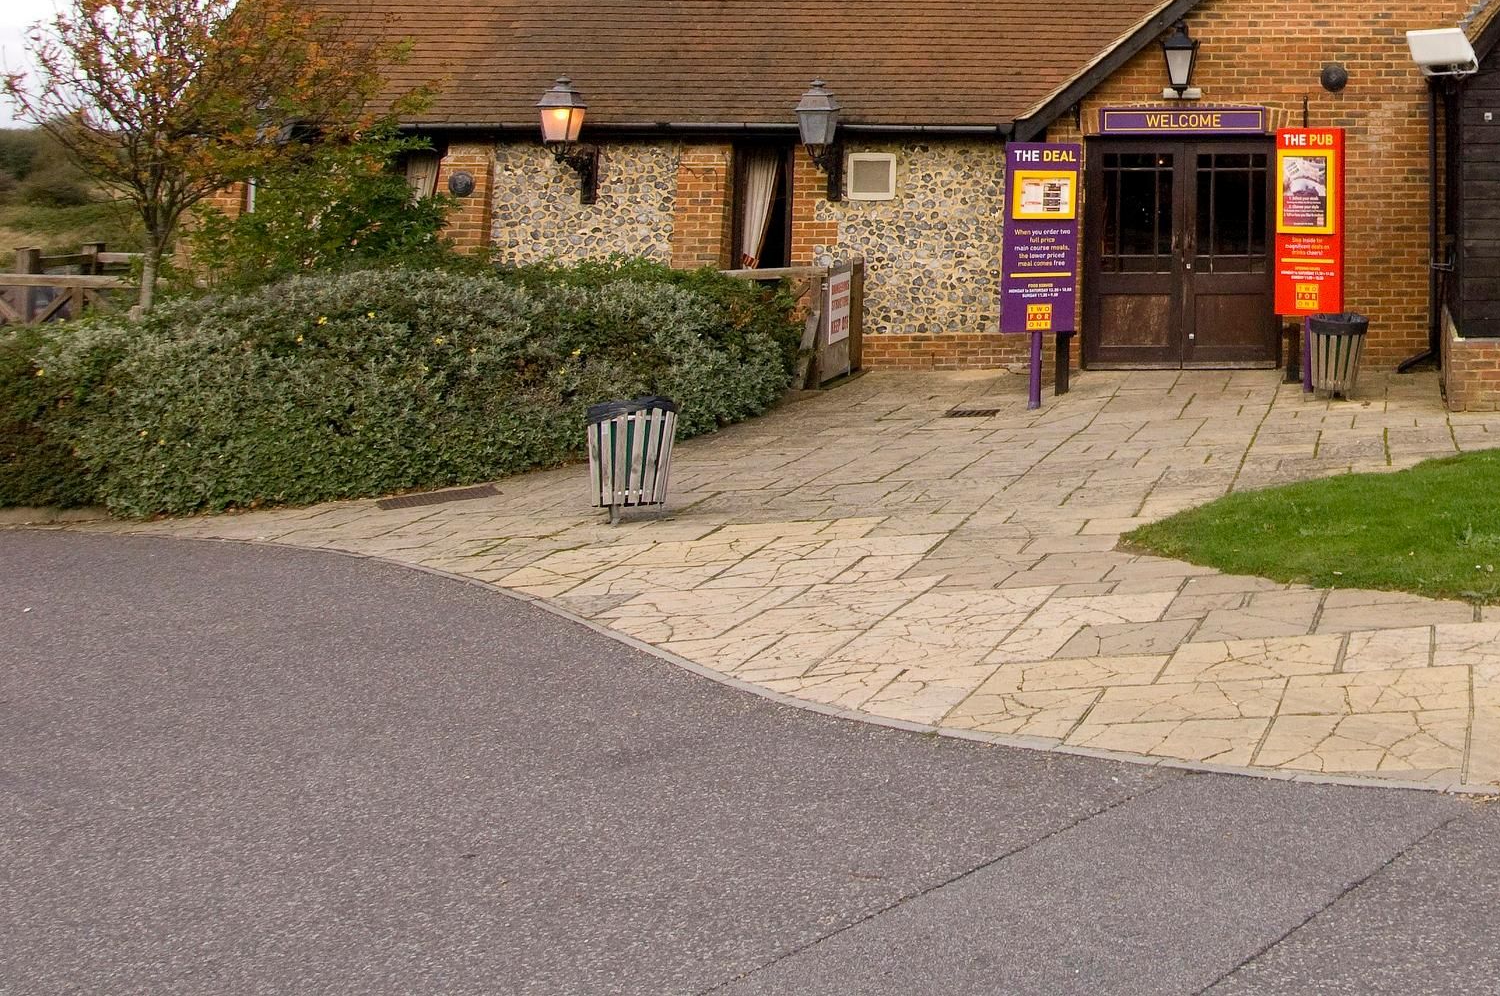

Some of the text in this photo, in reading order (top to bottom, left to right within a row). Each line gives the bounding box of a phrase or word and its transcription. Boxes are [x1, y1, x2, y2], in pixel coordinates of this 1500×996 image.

[1146, 114, 1222, 127] WELCOME
[1283, 134, 1334, 146] THE PUB
[1014, 149, 1077, 162] THE DEAL
